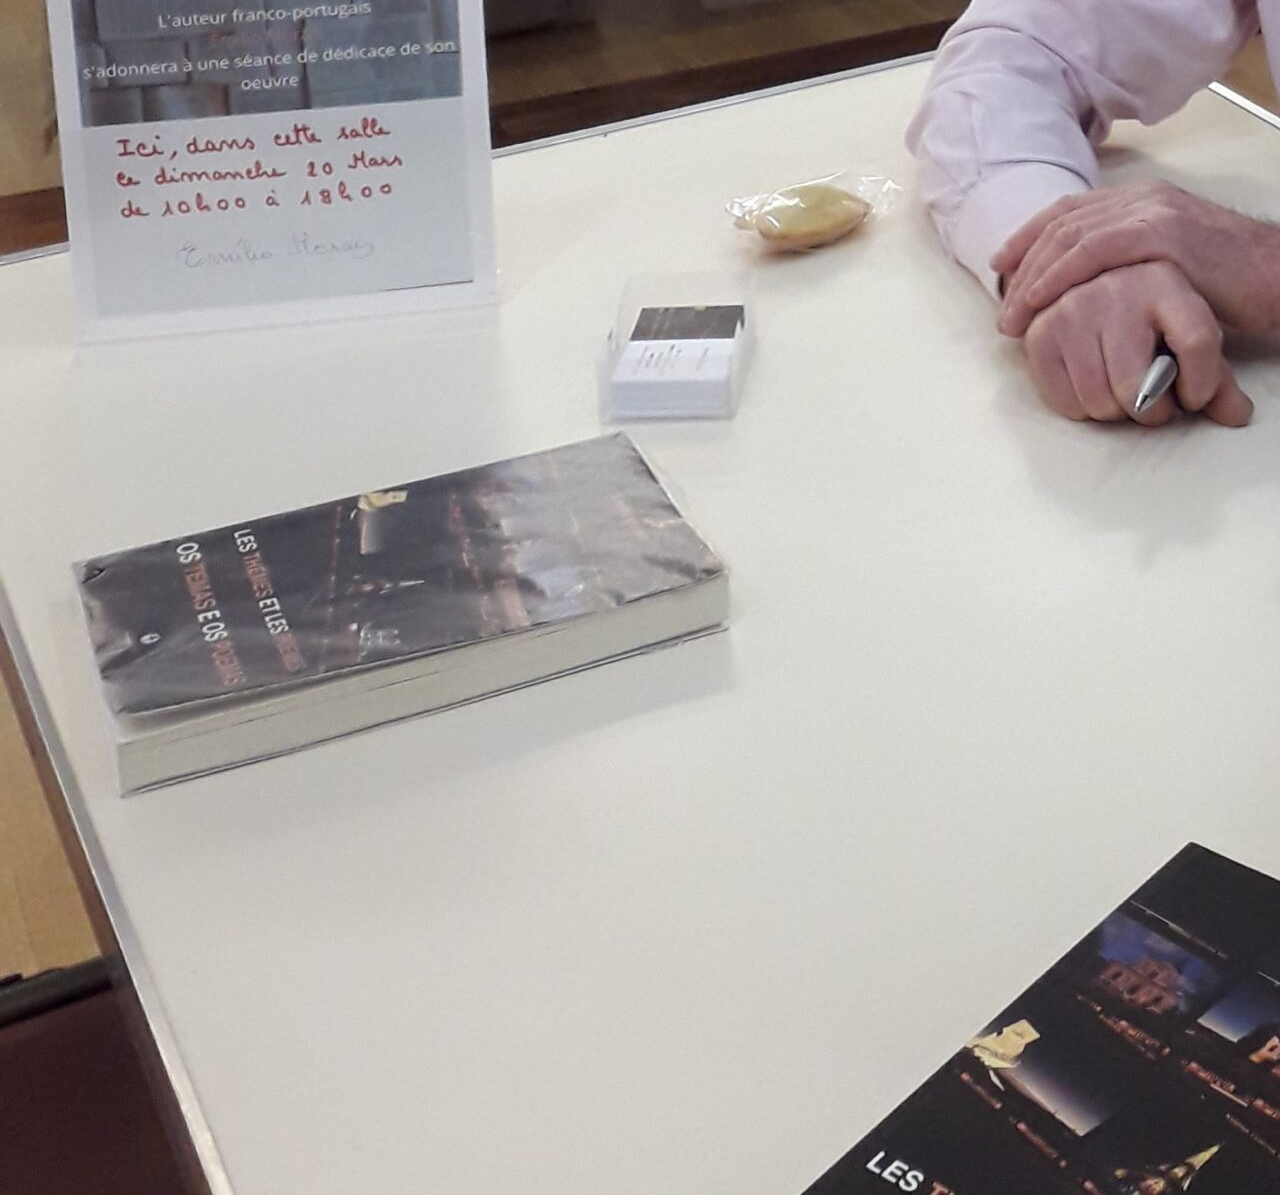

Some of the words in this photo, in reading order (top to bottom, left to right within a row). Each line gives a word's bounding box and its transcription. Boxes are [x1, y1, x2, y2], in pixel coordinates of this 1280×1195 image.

[158, 13, 227, 28] L'auteur
[232, 2, 372, 23] franco-portugais
[83, 62, 178, 80] s'adonnera
[183, 58, 192, 72] à
[198, 59, 229, 71] une
[235, 53, 292, 69] séance
[297, 50, 318, 64] de
[323, 45, 396, 61] dédicace
[400, 42, 421, 55] de
[425, 40, 455, 54] son
[241, 75, 299, 90] oeuvre
[187, 136, 255, 154] dans
[274, 123, 322, 146] cette
[337, 117, 391, 140] salle
[155, 159, 286, 185] dimanche
[307, 161, 333, 177] 20
[348, 150, 403, 169] Mars
[121, 200, 149, 218] de
[161, 192, 246, 217] 10h00
[266, 189, 280, 206] à
[300, 181, 392, 206] 18h00
[176, 542, 202, 563] OS
[233, 528, 258, 553] LES
[197, 609, 221, 623] E
[258, 597, 281, 613] ET
[201, 622, 229, 642] OS
[264, 613, 289, 635] LES
[866, 1151, 924, 1192] LES
